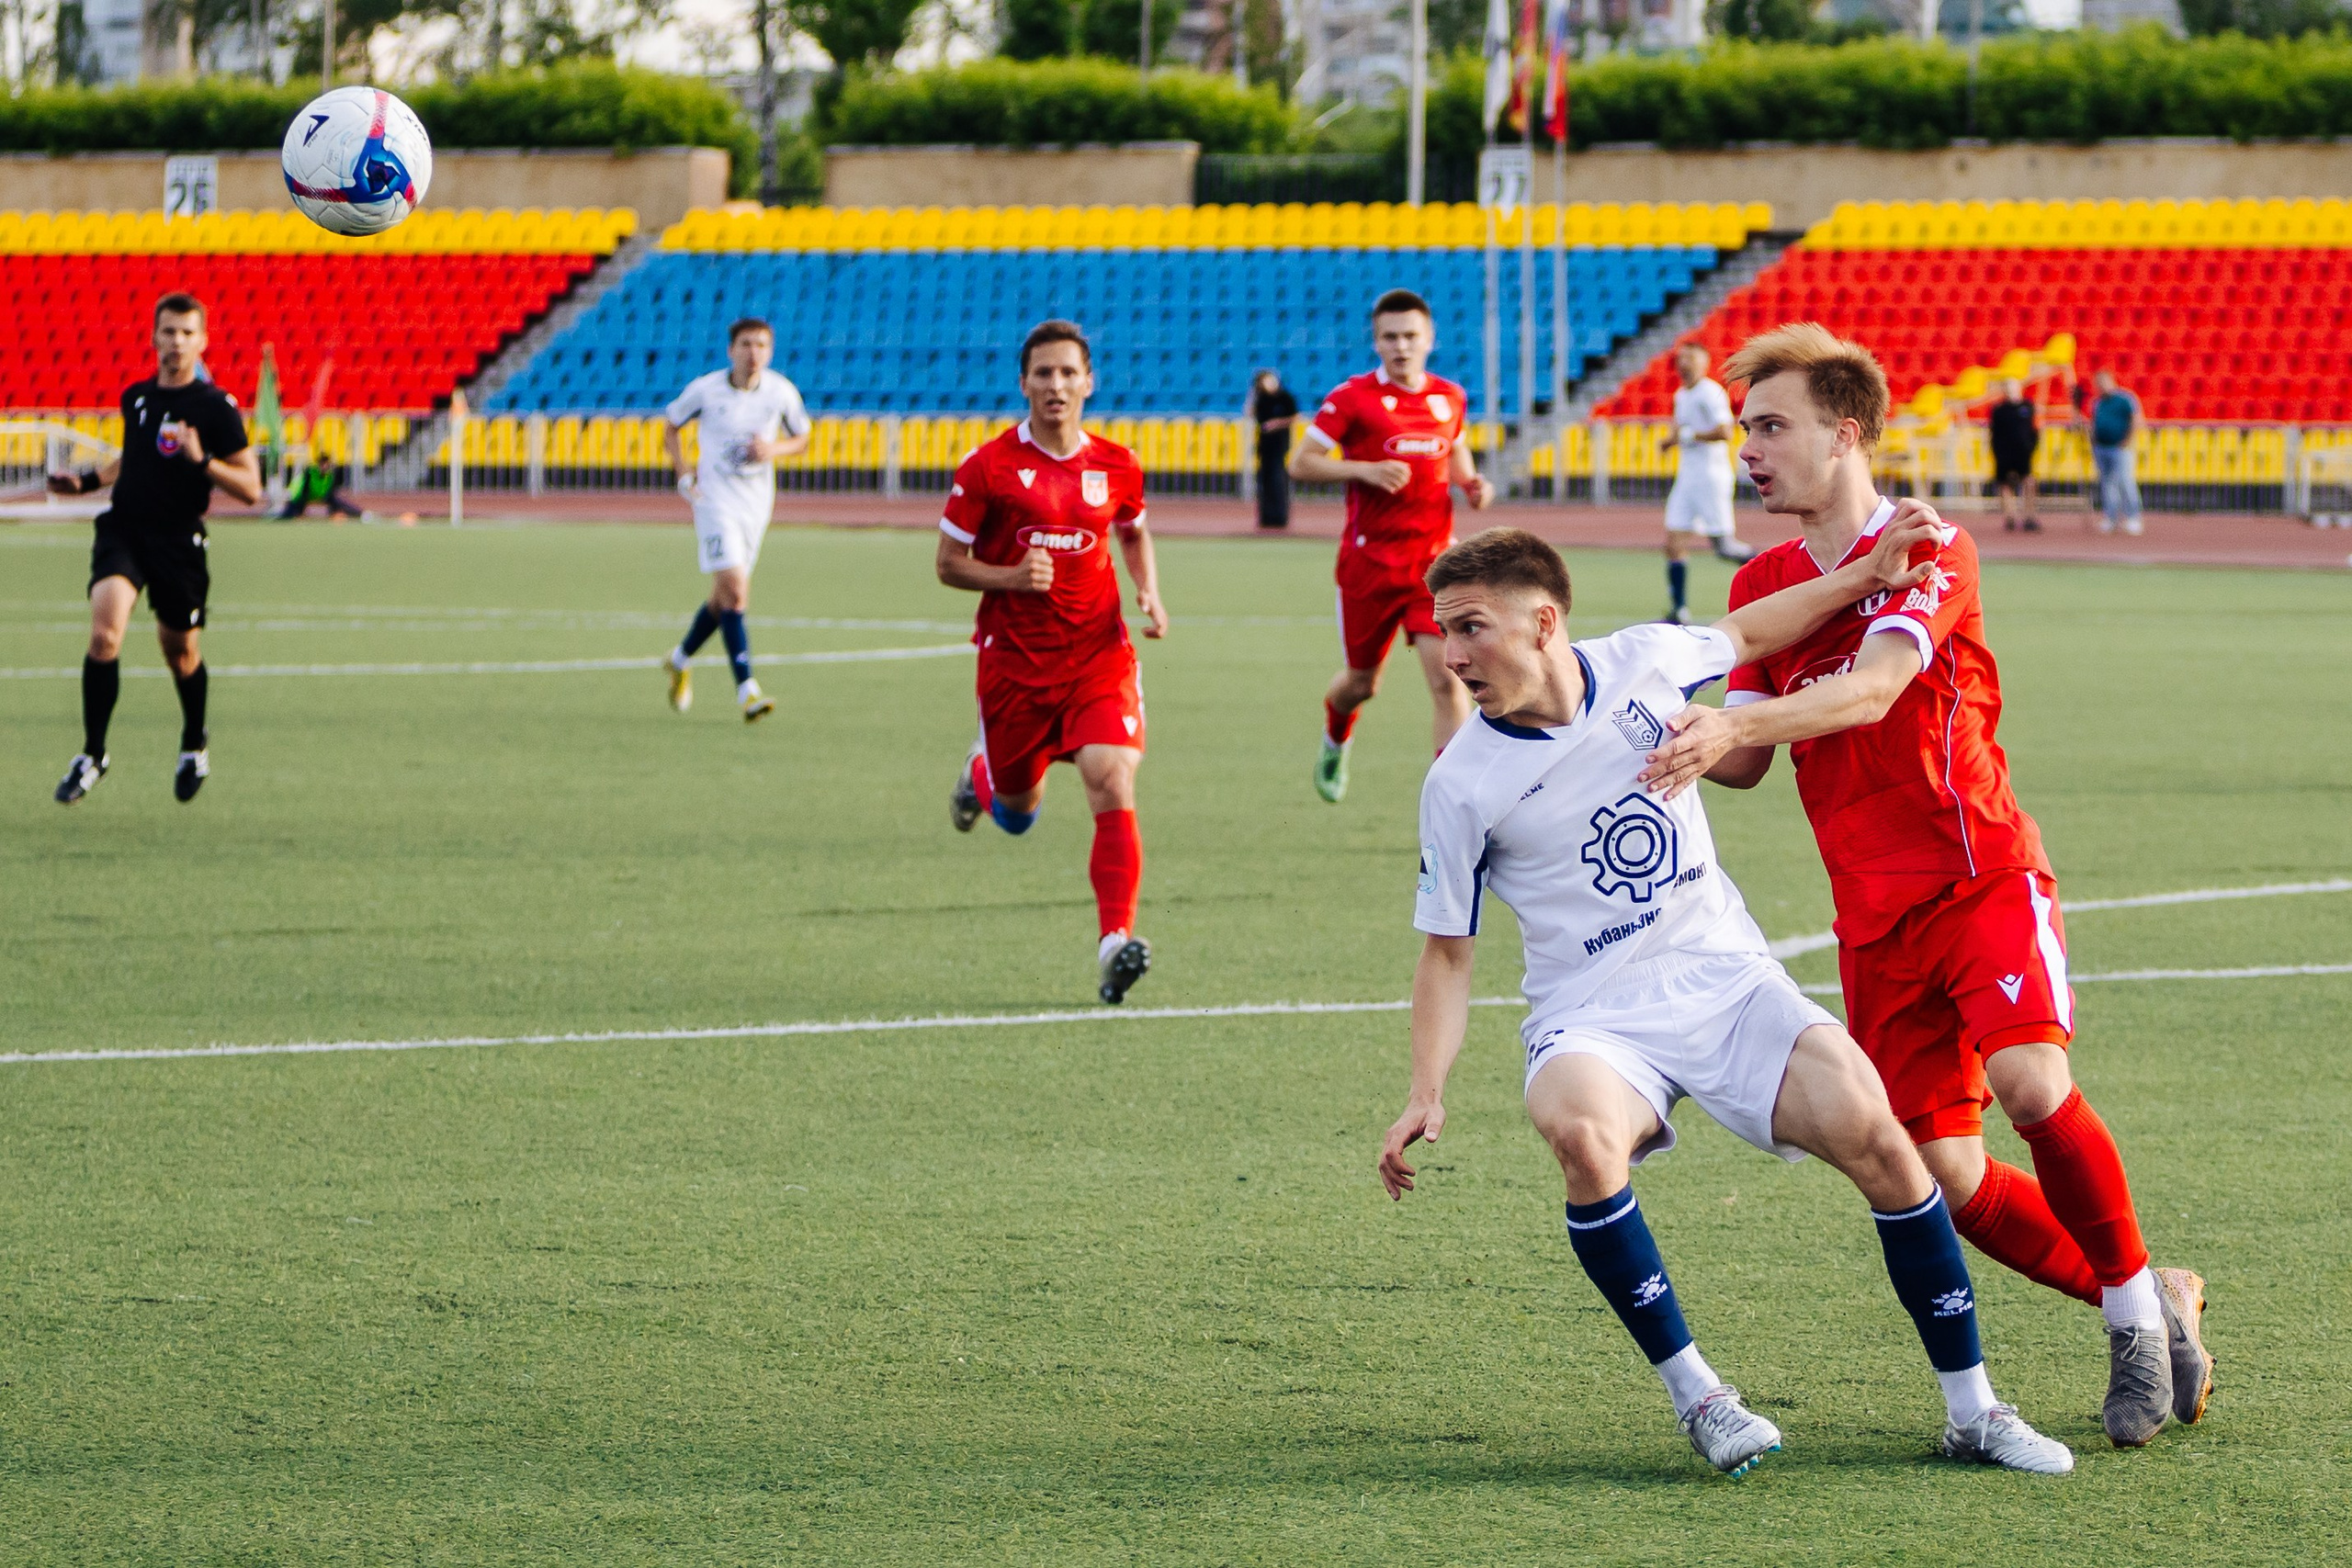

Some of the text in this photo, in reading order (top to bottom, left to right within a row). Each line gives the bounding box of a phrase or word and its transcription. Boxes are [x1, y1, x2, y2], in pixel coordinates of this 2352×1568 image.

[1029, 531, 1084, 550] amet
[1634, 1283, 1668, 1308] KELME
[1934, 1301, 1973, 1316] KELME
